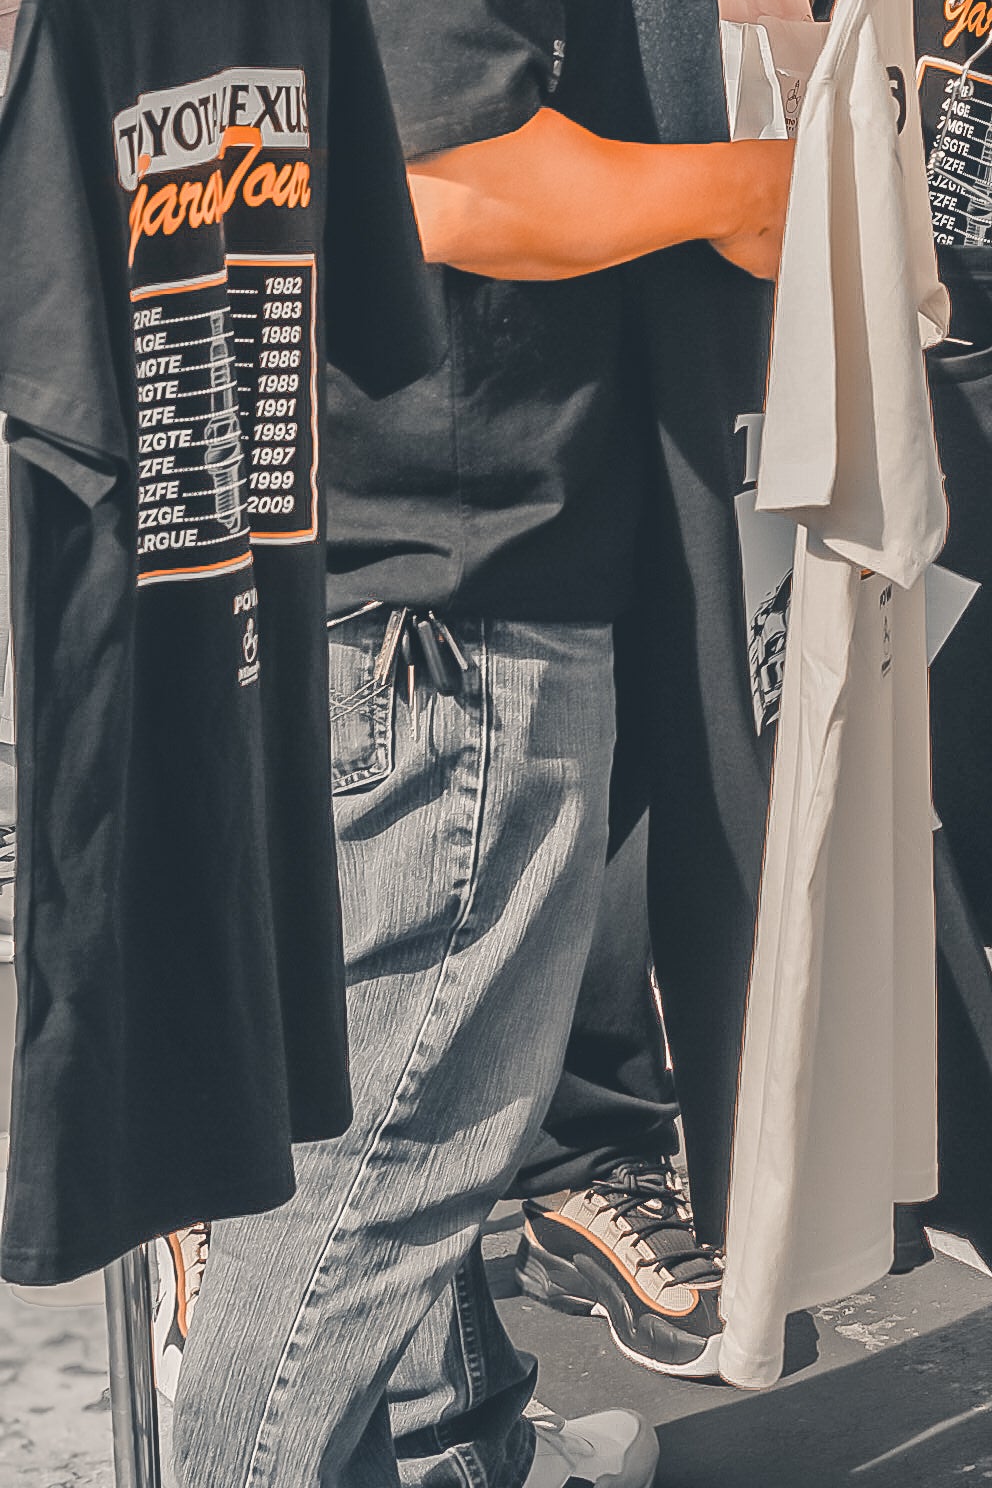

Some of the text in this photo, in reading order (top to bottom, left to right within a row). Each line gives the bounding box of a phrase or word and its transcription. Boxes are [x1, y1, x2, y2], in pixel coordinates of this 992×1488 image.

[218, 124, 312, 214] Tour
[932, 211, 956, 231] ZFE
[265, 276, 303, 295] 1982
[263, 301, 303, 320] 1983
[261, 325, 302, 345] 1986
[259, 350, 301, 369] 1986
[258, 374, 299, 393] 1989
[255, 398, 297, 418] 1991
[253, 422, 298, 442] 1993
[251, 446, 297, 466] 1997
[249, 471, 295, 490] 1999
[246, 495, 295, 514] 2009
